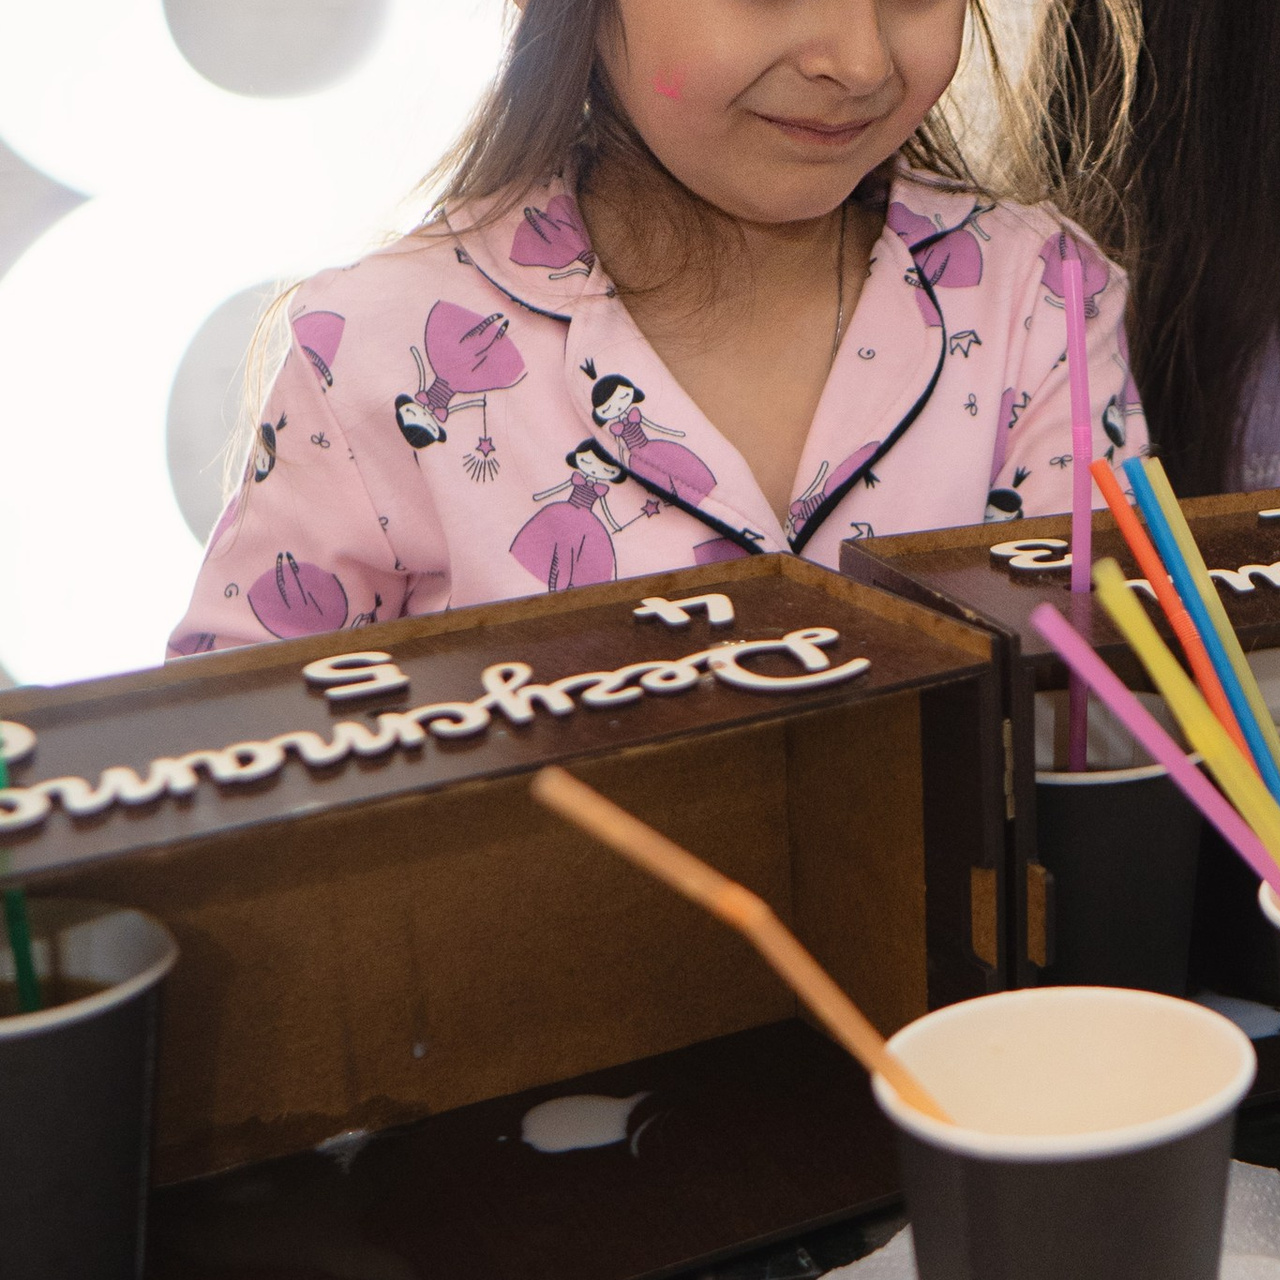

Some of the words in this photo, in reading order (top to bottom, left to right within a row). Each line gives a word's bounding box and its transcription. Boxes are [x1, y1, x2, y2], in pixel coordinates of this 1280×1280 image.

[989, 538, 1074, 570] 3
[632, 593, 736, 626] 4
[302, 651, 411, 700] 5
